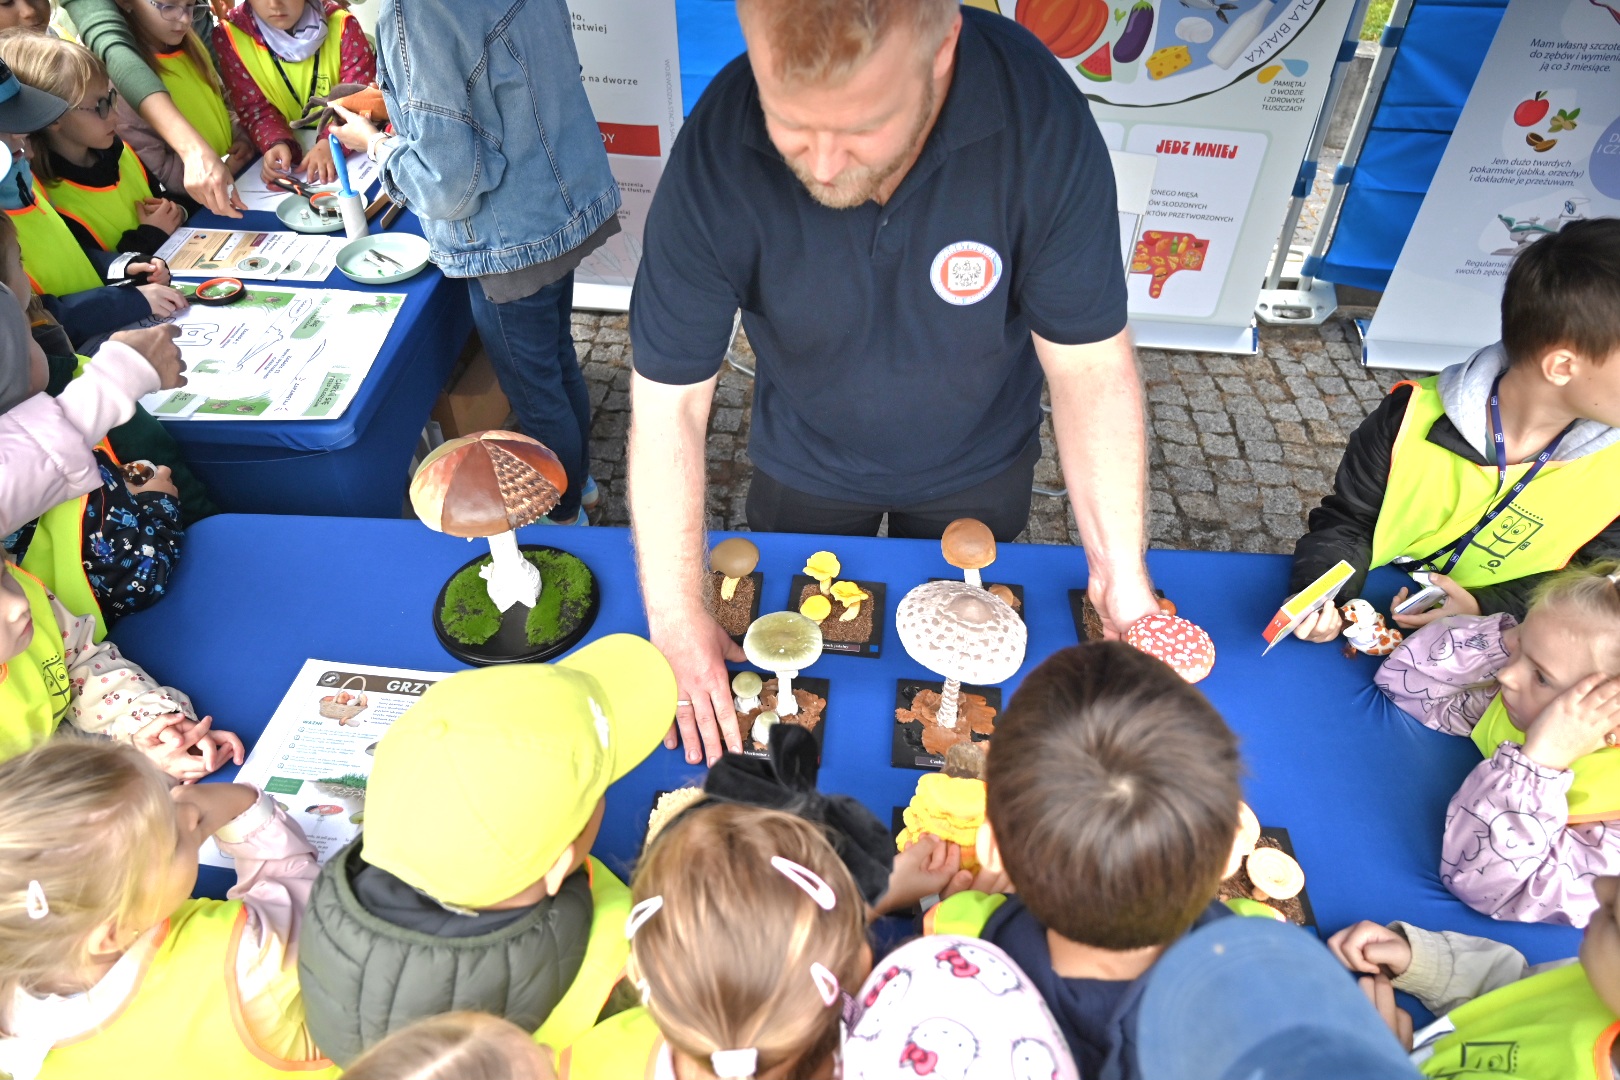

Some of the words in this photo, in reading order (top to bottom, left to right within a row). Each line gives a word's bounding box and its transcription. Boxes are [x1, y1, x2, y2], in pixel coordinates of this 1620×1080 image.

[572, 22, 607, 34] łatwiej
[1244, 23, 1291, 62] BIAŁKA
[1530, 38, 1555, 48] Mam
[1556, 40, 1588, 52] własną
[1530, 50, 1543, 58] do
[1544, 51, 1575, 61] zębów
[1576, 52, 1580, 60] i
[1538, 62, 1549, 72] ją
[1563, 62, 1570, 70] 3
[1571, 63, 1611, 73] miesiące.
[602, 75, 638, 86] dworze
[1273, 80, 1306, 88] PAMIĘTAJ
[1262, 104, 1303, 112] TŁUSZCZACH
[1156, 140, 1191, 155] JEDZ
[1192, 142, 1238, 159] MNIEJ
[1603, 144, 1620, 154] CZ
[1491, 157, 1509, 165] Jem
[1510, 158, 1531, 166] dużo
[1532, 159, 1572, 168] twardych
[1469, 166, 1516, 175] pokarmów
[1516, 168, 1546, 176] (jabłka,
[1548, 169, 1584, 178] orzechy)
[1474, 175, 1515, 184] dokładnie
[1515, 178, 1525, 186] je
[1525, 178, 1575, 187] przeżuwam.
[1150, 189, 1176, 197] ONEGO
[1161, 201, 1208, 210] SŁODZONYCH
[1168, 211, 1234, 222] PRZETWORZONYCH
[1465, 260, 1506, 268] Regularnie
